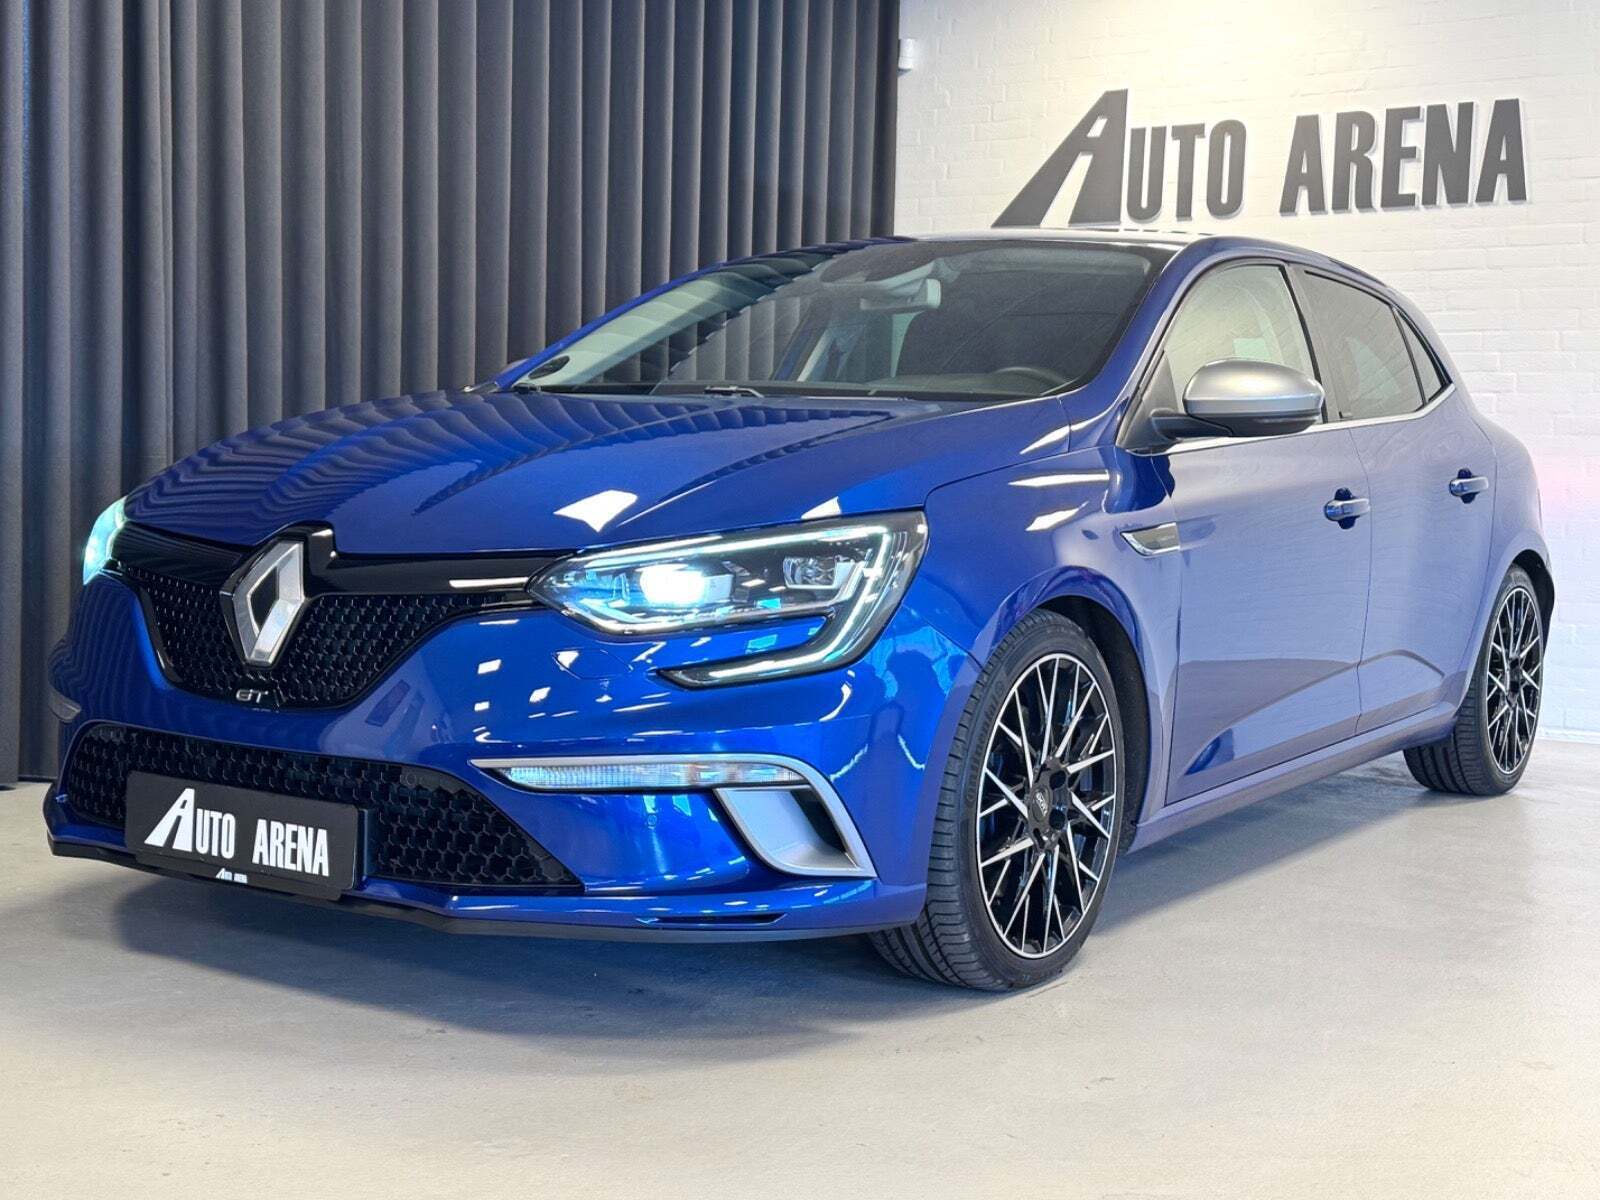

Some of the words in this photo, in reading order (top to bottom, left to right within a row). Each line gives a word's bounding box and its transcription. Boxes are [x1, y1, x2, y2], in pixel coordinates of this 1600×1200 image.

[991, 88, 1247, 228] AUTO
[1280, 98, 1527, 216] ARENA
[236, 689, 269, 703] GT
[144, 788, 236, 859] AUTO
[252, 819, 329, 877] ARENA
